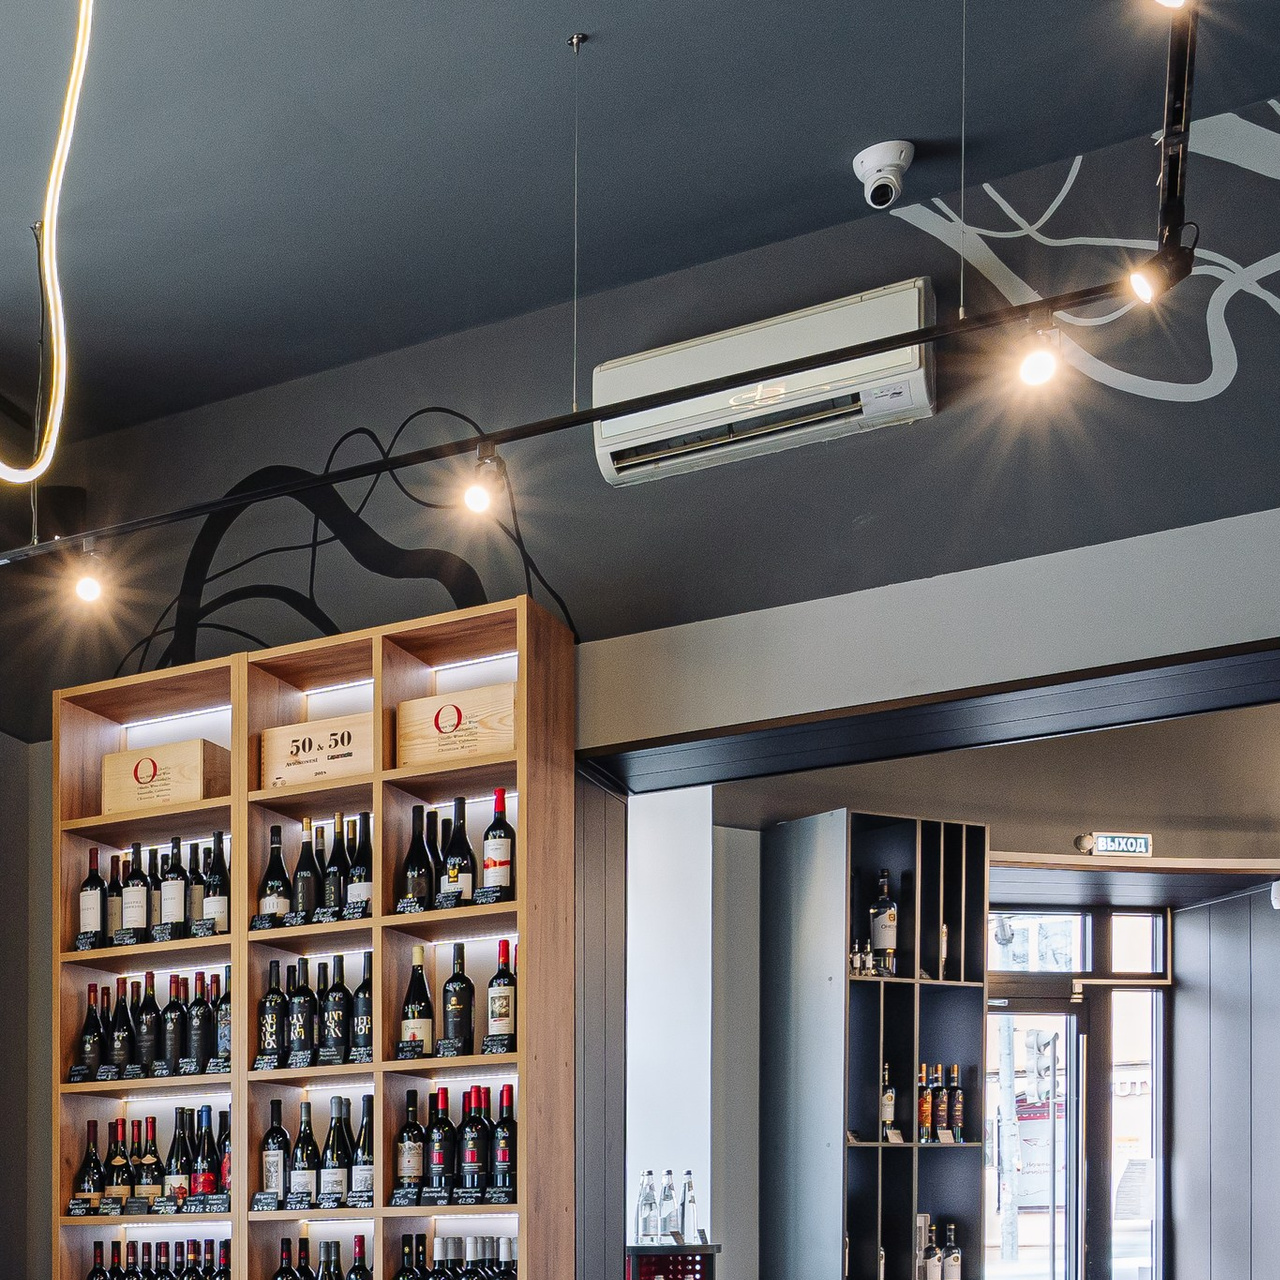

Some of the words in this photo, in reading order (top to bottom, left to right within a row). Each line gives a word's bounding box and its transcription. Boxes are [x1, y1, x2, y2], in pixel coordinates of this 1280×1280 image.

[290, 737, 313, 756] 50
[328, 730, 352, 749] 50
[1097, 837, 1146, 853] ВЫХОД
